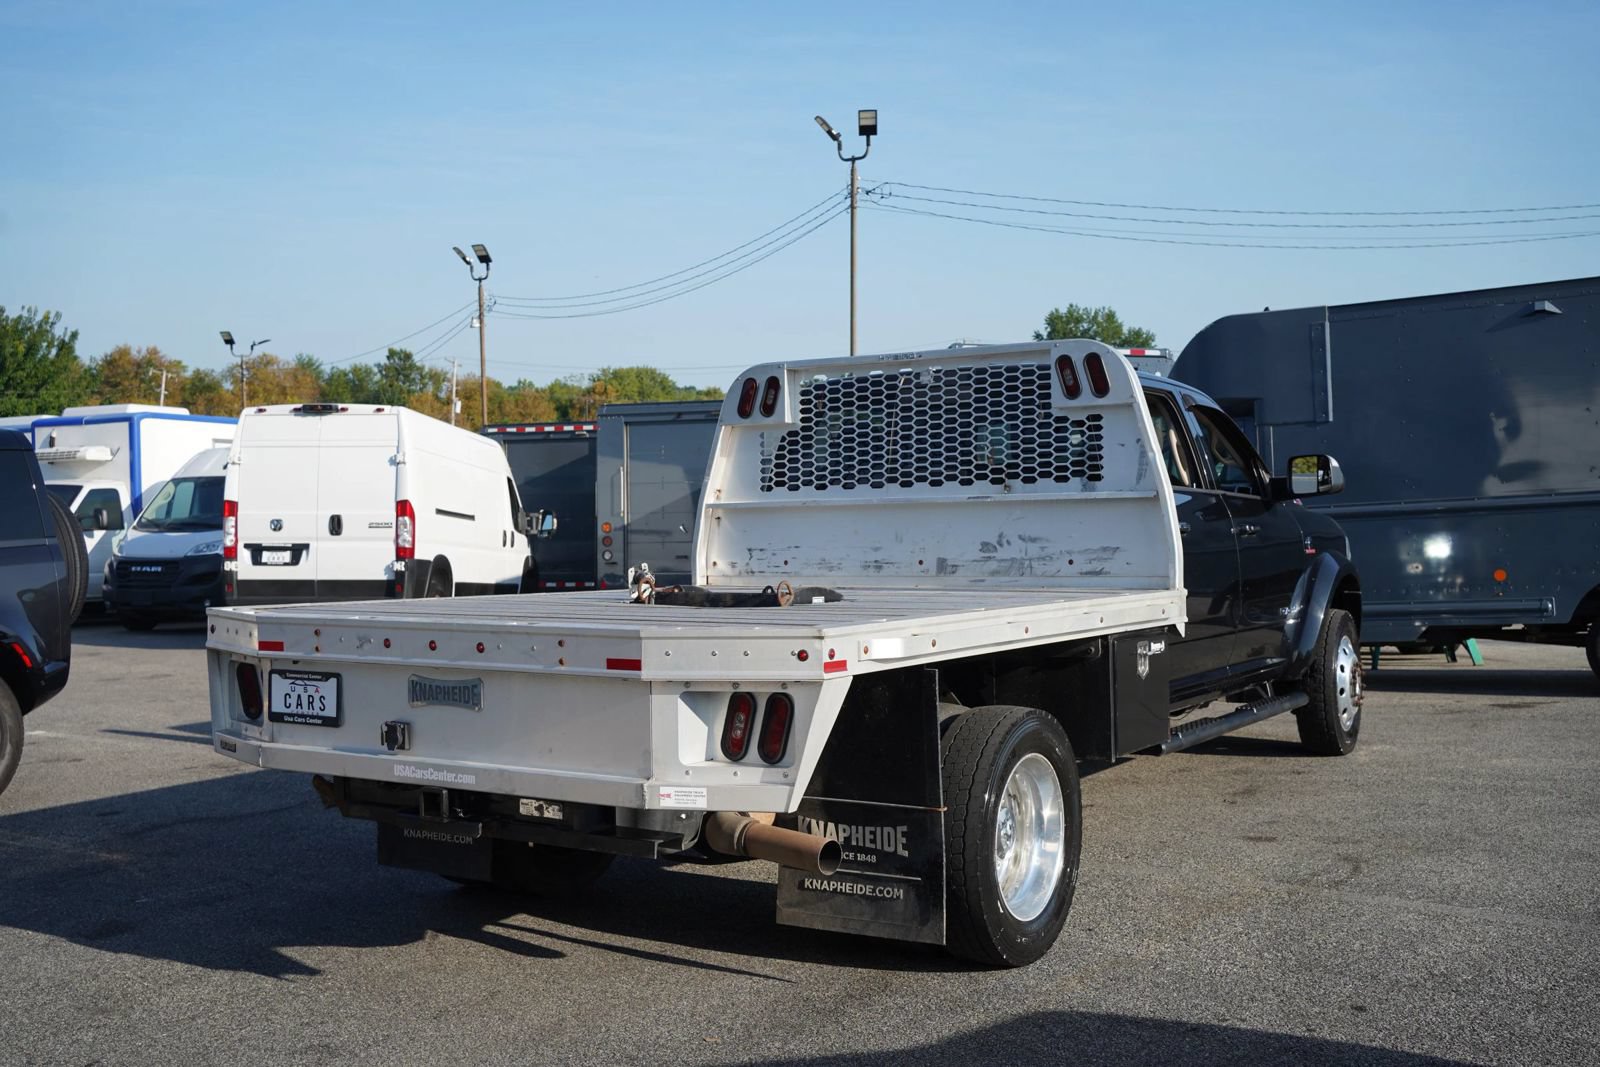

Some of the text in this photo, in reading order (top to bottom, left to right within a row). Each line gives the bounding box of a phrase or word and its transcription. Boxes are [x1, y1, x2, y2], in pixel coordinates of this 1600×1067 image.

[284, 693, 326, 711] CARS
[411, 679, 481, 706] KNAPHEIDE
[393, 764, 476, 784] USACarsCenter.com
[404, 828, 473, 844] KNAPHEIDE.COM
[856, 853, 877, 863] 1848
[804, 878, 904, 899] KNAPHEIDE.COM
